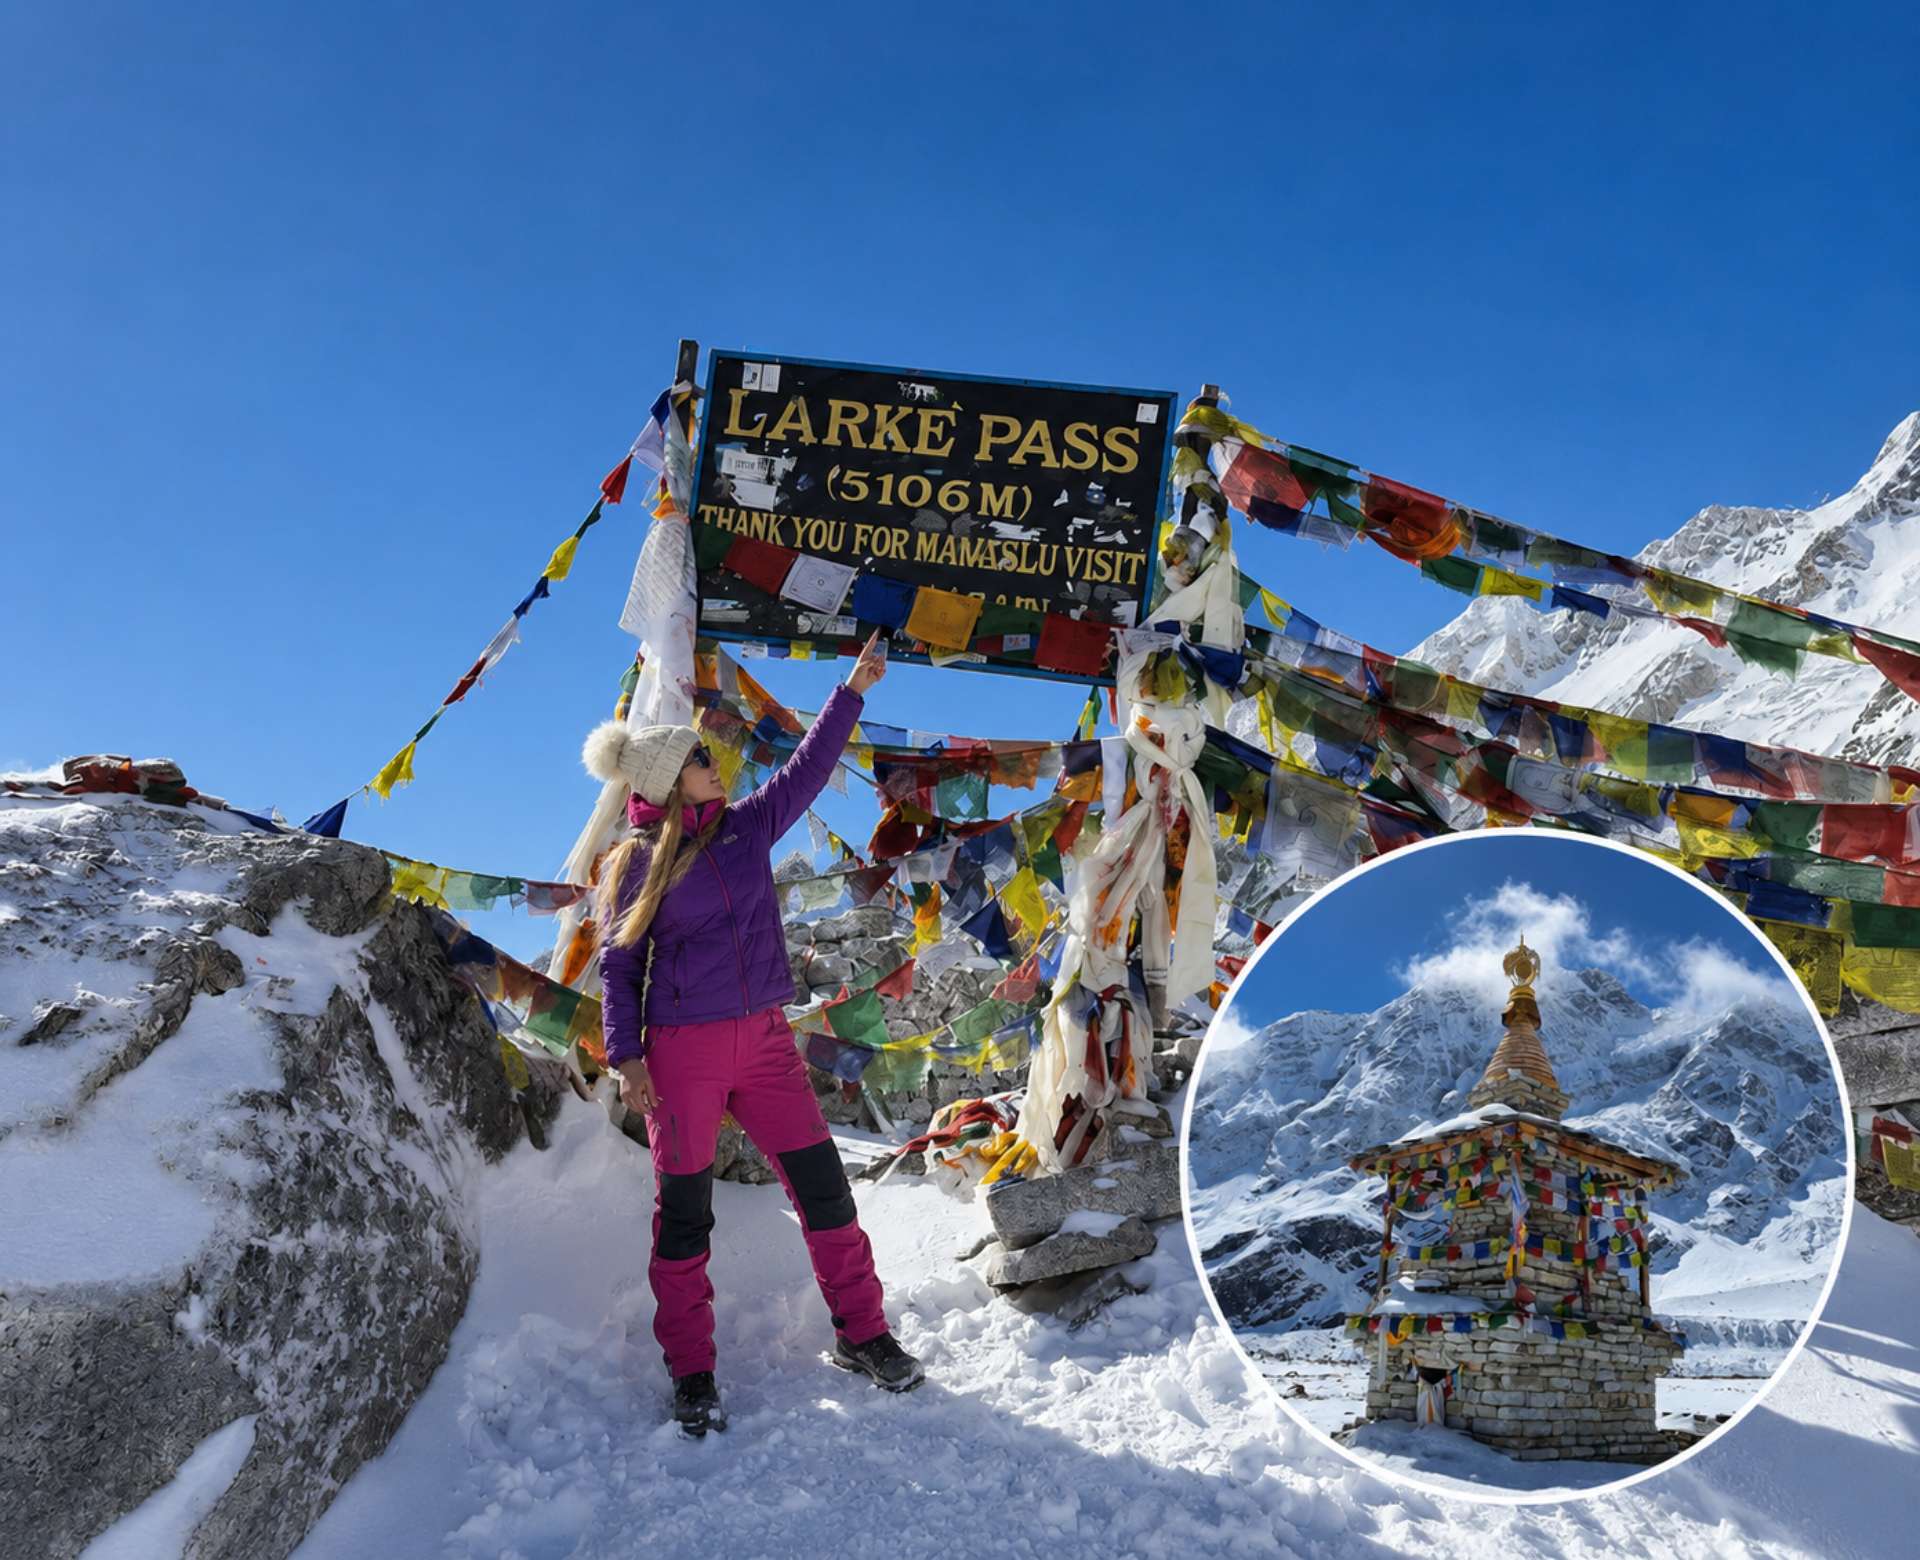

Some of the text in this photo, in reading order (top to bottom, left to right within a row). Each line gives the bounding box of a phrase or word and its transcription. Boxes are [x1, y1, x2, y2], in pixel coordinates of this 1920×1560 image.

[723, 389, 1140, 474] LARKE PASS
[698, 504, 1147, 585] THANK YOU FOR MANASLU VISIT
